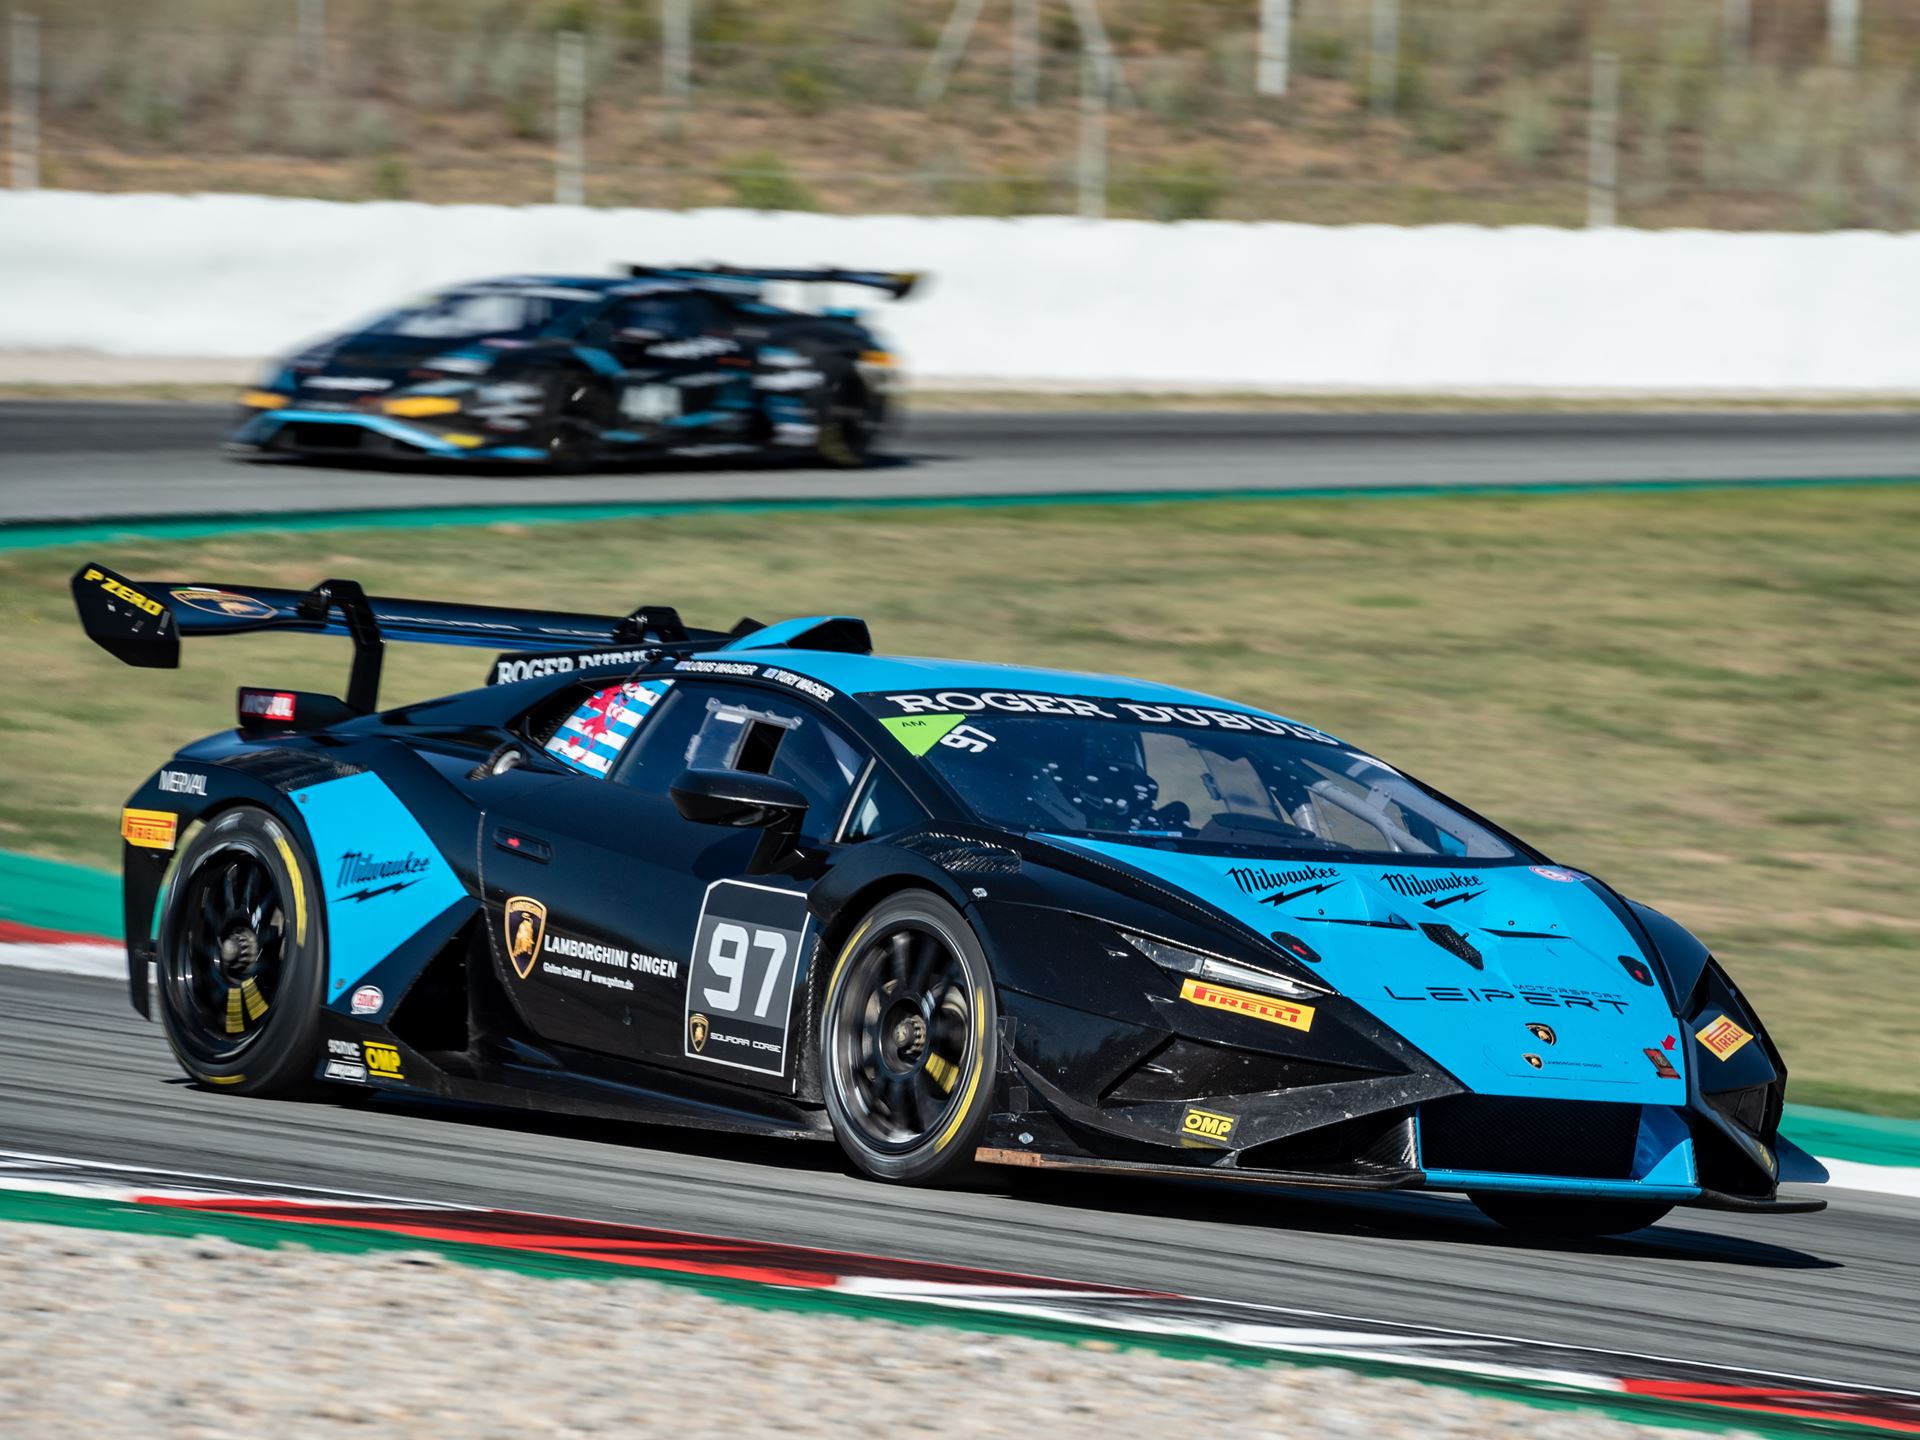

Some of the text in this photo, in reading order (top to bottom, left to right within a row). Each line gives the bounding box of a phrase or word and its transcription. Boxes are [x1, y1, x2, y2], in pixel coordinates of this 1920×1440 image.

[83, 568, 104, 582] P
[101, 577, 165, 616] ZERO
[687, 661, 759, 676] LOUIS WAGNER
[795, 677, 835, 702] WAGNER
[885, 692, 1339, 746] ROGER DUBUIS
[900, 720, 927, 728] AM
[939, 724, 997, 753] 97
[127, 816, 176, 842] PIRELLI
[337, 850, 431, 889] Milwaukee
[1224, 864, 1342, 896] Milwaukee
[1379, 871, 1485, 897] Milwaukee
[544, 934, 678, 979] LAMBORGHINI SINGEN
[703, 922, 787, 1018] 97
[1193, 985, 1301, 1024] PIRELLI
[1384, 985, 1629, 1015] LEIPERT
[1513, 983, 1622, 999] MOTORSPORT
[710, 1032, 782, 1054] SQUADRA CORSE
[1704, 1021, 1744, 1054] PIRELLI
[365, 1047, 401, 1073] OMP
[1185, 1114, 1232, 1136] OMP
